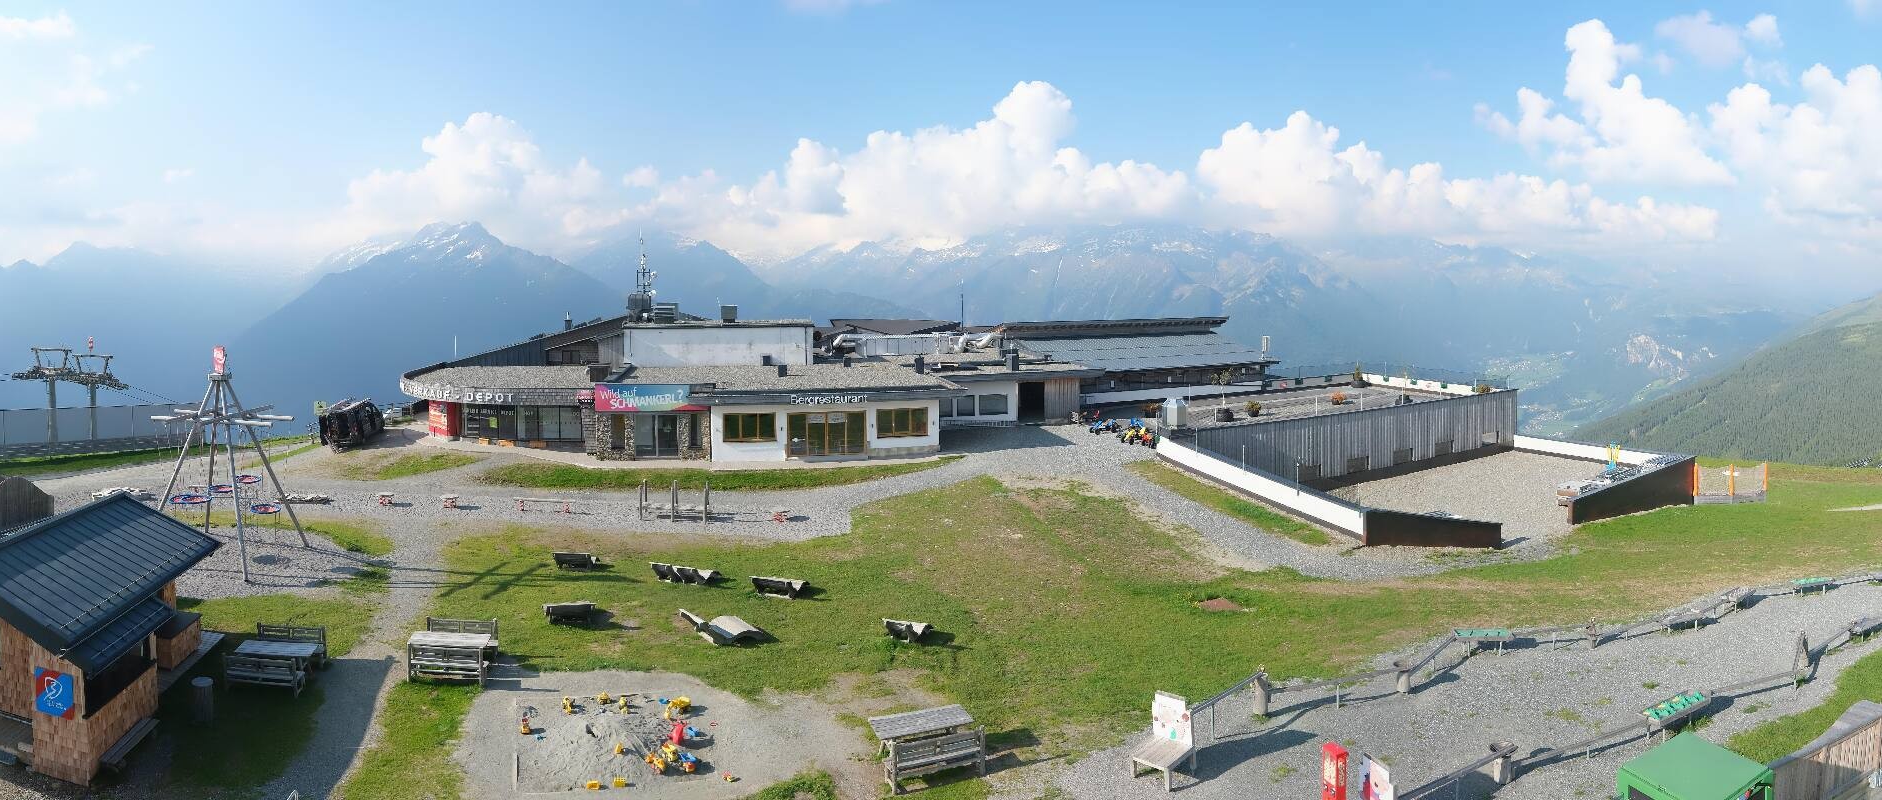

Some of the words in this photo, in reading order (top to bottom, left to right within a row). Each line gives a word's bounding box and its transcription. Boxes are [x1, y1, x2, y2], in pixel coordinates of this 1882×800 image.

[466, 392, 514, 402] DEPOT
[600, 388, 620, 399] Wild
[622, 386, 637, 398] auf
[609, 389, 684, 409] SCHMANKERL?
[790, 394, 868, 406] Bergrestaurant
